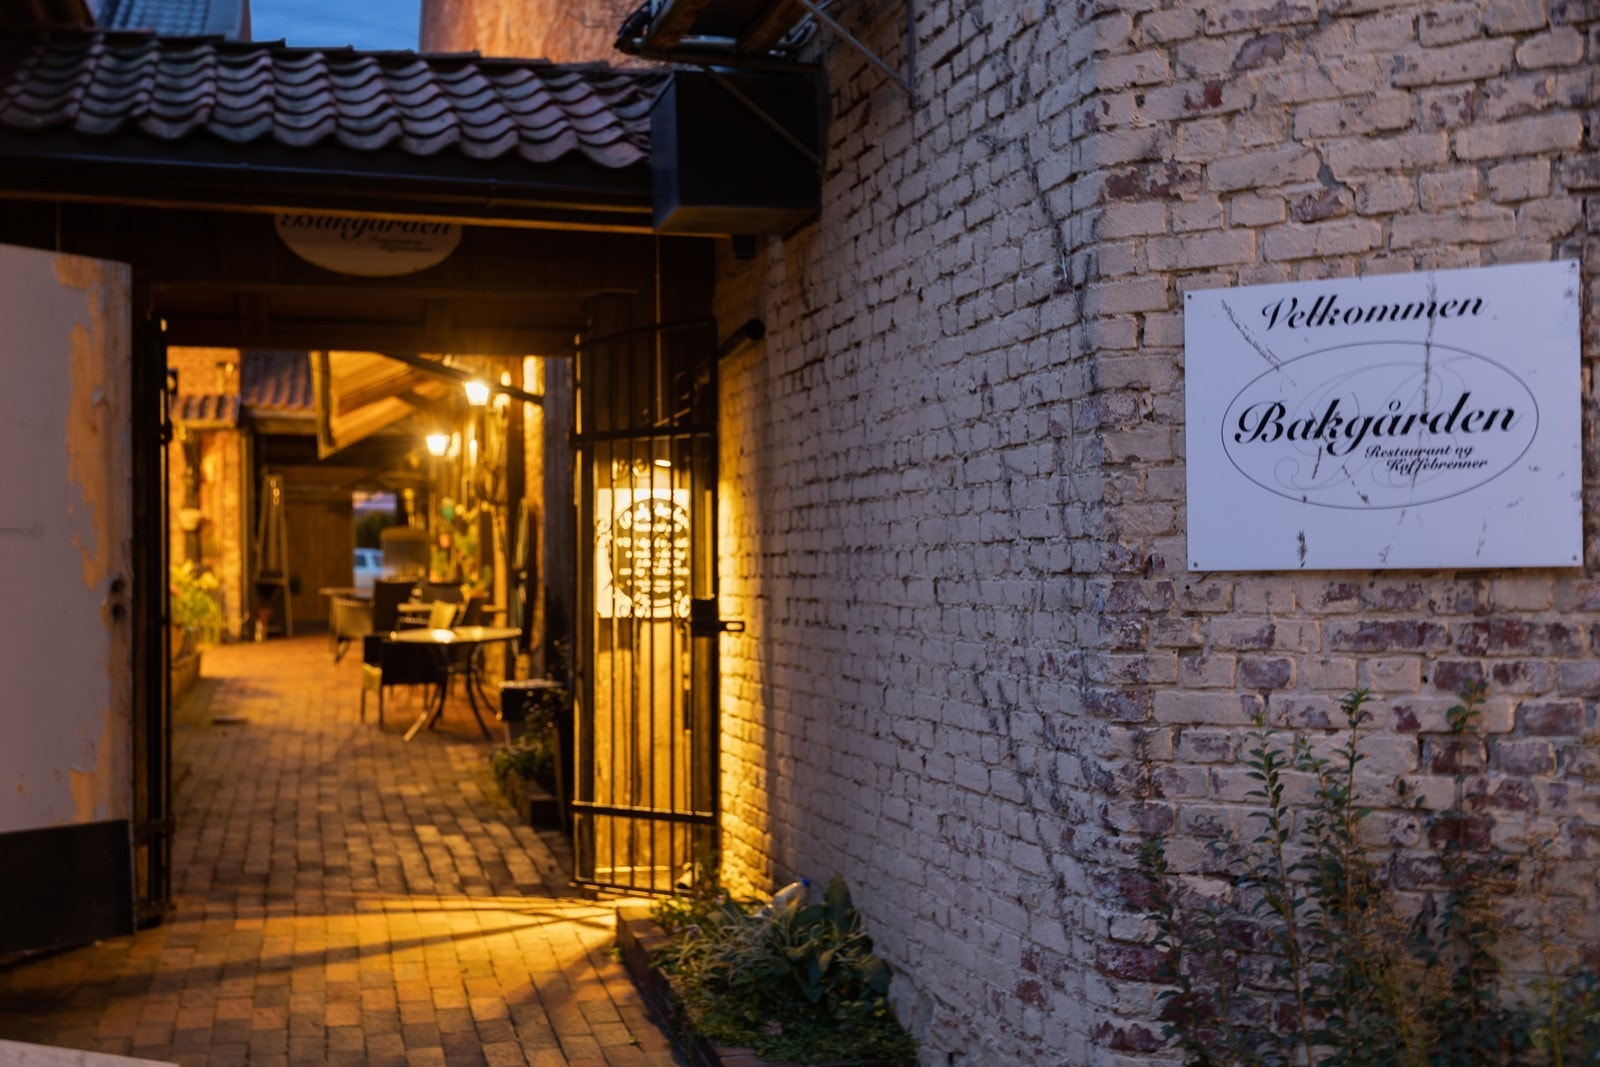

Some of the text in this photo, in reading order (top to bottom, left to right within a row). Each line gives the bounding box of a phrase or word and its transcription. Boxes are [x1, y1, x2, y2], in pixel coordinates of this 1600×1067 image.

[1261, 293, 1486, 332] Velkommen
[1233, 391, 1519, 457] Bakgården
[1364, 444, 1474, 459] Restaurant og
[1386, 456, 1488, 476] Kaffebrenner
